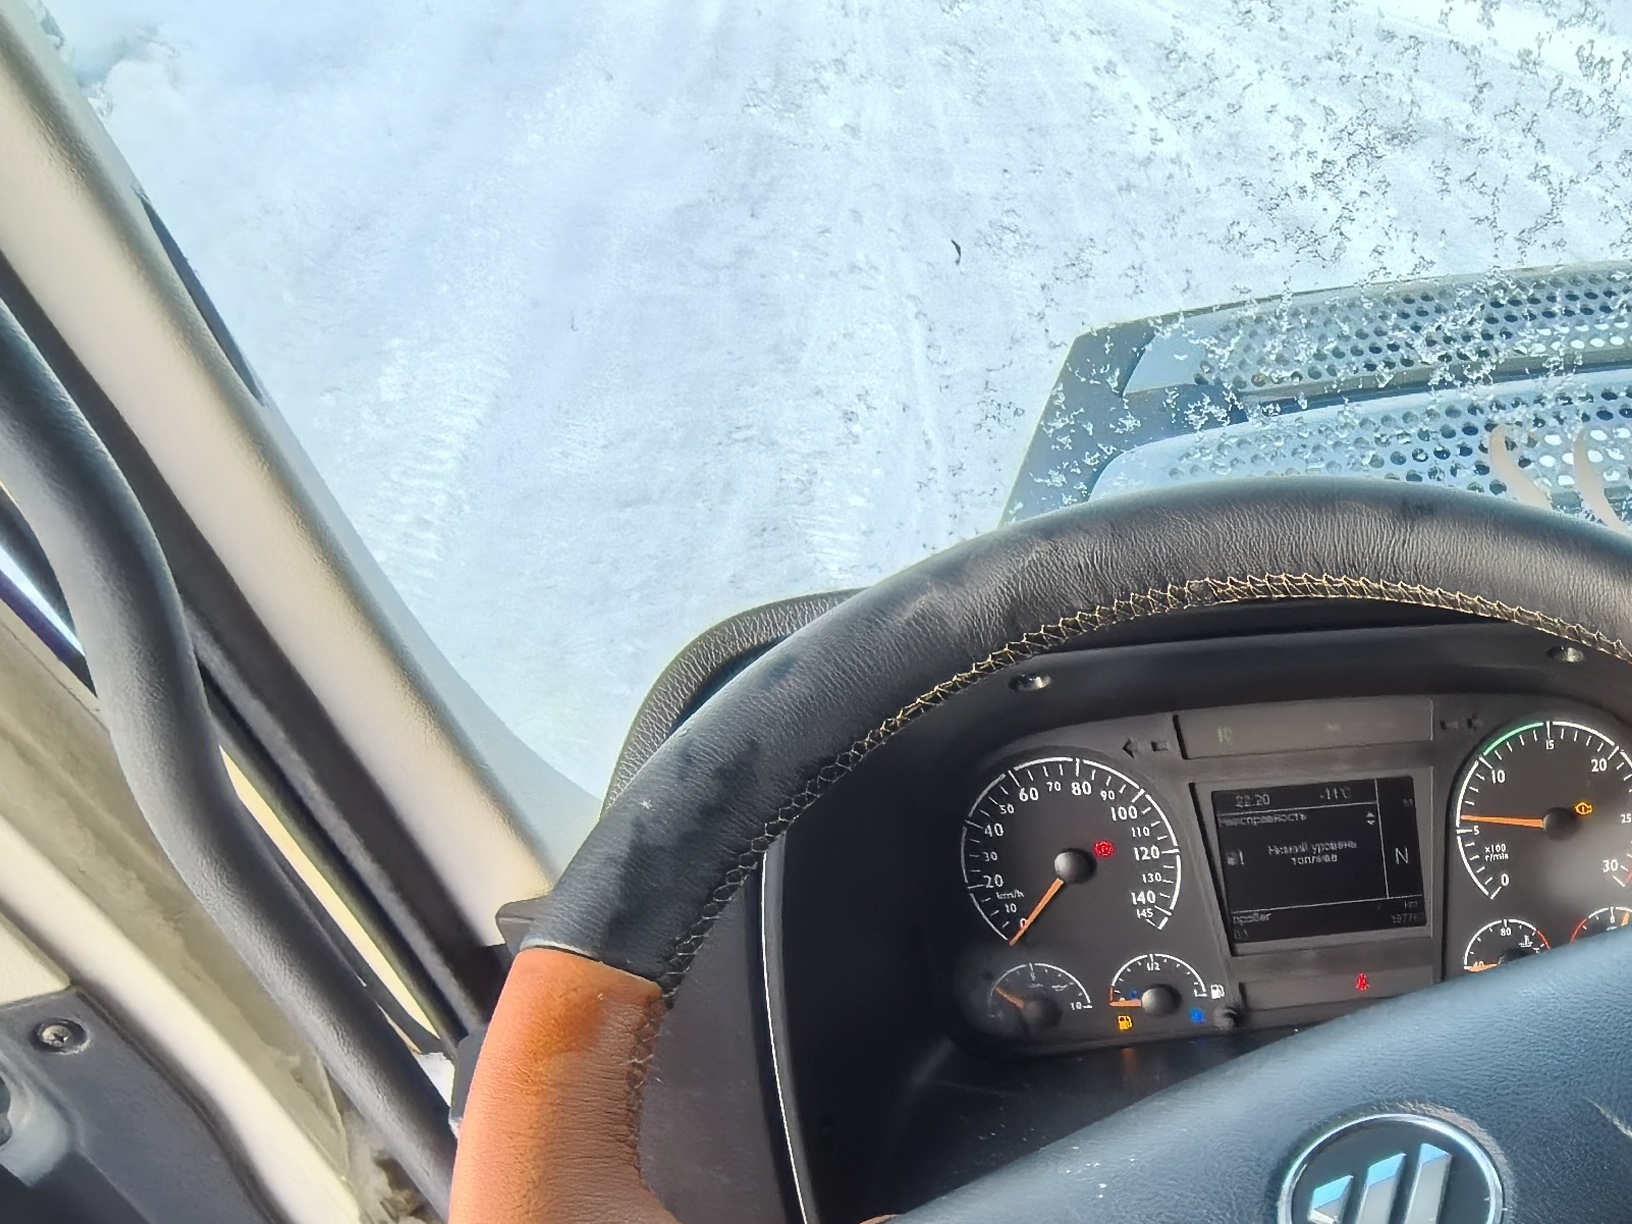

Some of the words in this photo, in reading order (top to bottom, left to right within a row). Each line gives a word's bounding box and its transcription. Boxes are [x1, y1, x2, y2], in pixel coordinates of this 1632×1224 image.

[1545, 740, 1555, 750] 15
[1591, 758, 1608, 772] 20
[1491, 770, 1506, 784] 10
[1047, 781, 1062, 792] 70
[1071, 781, 1092, 796] 80
[1019, 788, 1039, 801] 60
[1100, 790, 1115, 801] 90
[1000, 804, 1015, 815] 50
[1111, 805, 1138, 821] 100
[1621, 814, 1632, 824] 25
[984, 823, 1004, 837] 40
[1132, 826, 1150, 837] 110
[1473, 826, 1480, 836] 5
[984, 851, 998, 862] 30
[1134, 845, 1160, 860] 120
[1395, 846, 1409, 865] N
[1603, 859, 1619, 872] 30
[983, 874, 1004, 888] 20
[1142, 872, 1162, 883] 130
[1131, 890, 1156, 905] 140
[1005, 903, 1017, 913] 10
[1136, 908, 1153, 919] 145
[1500, 928, 1512, 937] 80
